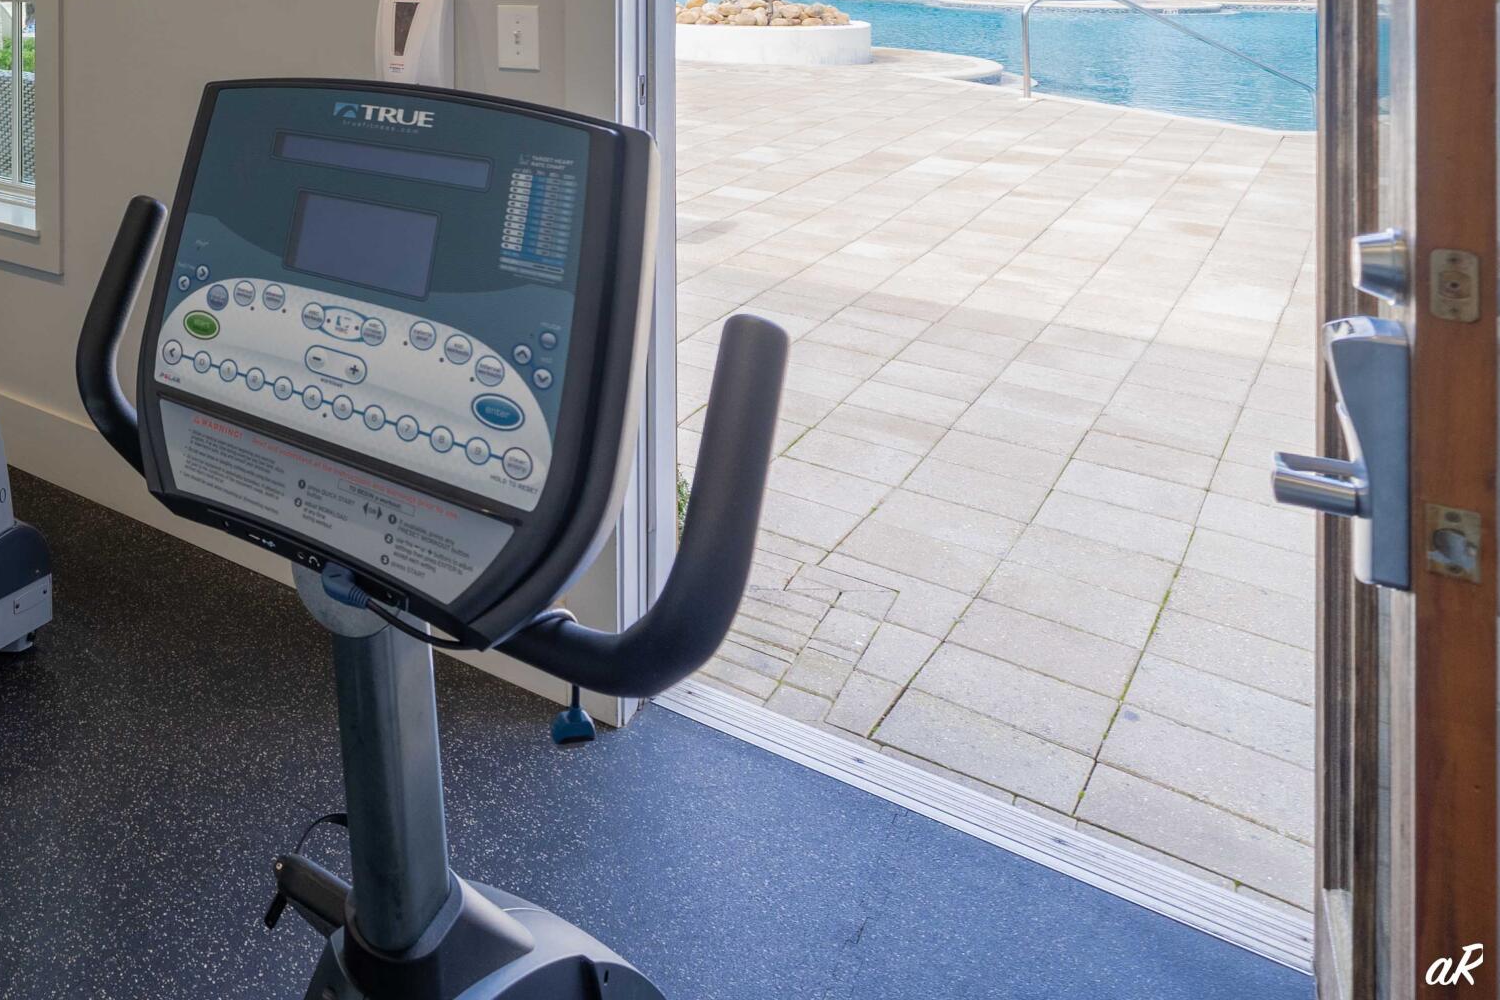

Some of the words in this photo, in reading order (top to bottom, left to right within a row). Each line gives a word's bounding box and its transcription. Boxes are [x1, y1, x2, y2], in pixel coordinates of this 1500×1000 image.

[360, 104, 436, 128] TRUE
[484, 406, 511, 418] enter
[518, 483, 539, 495] RESET
